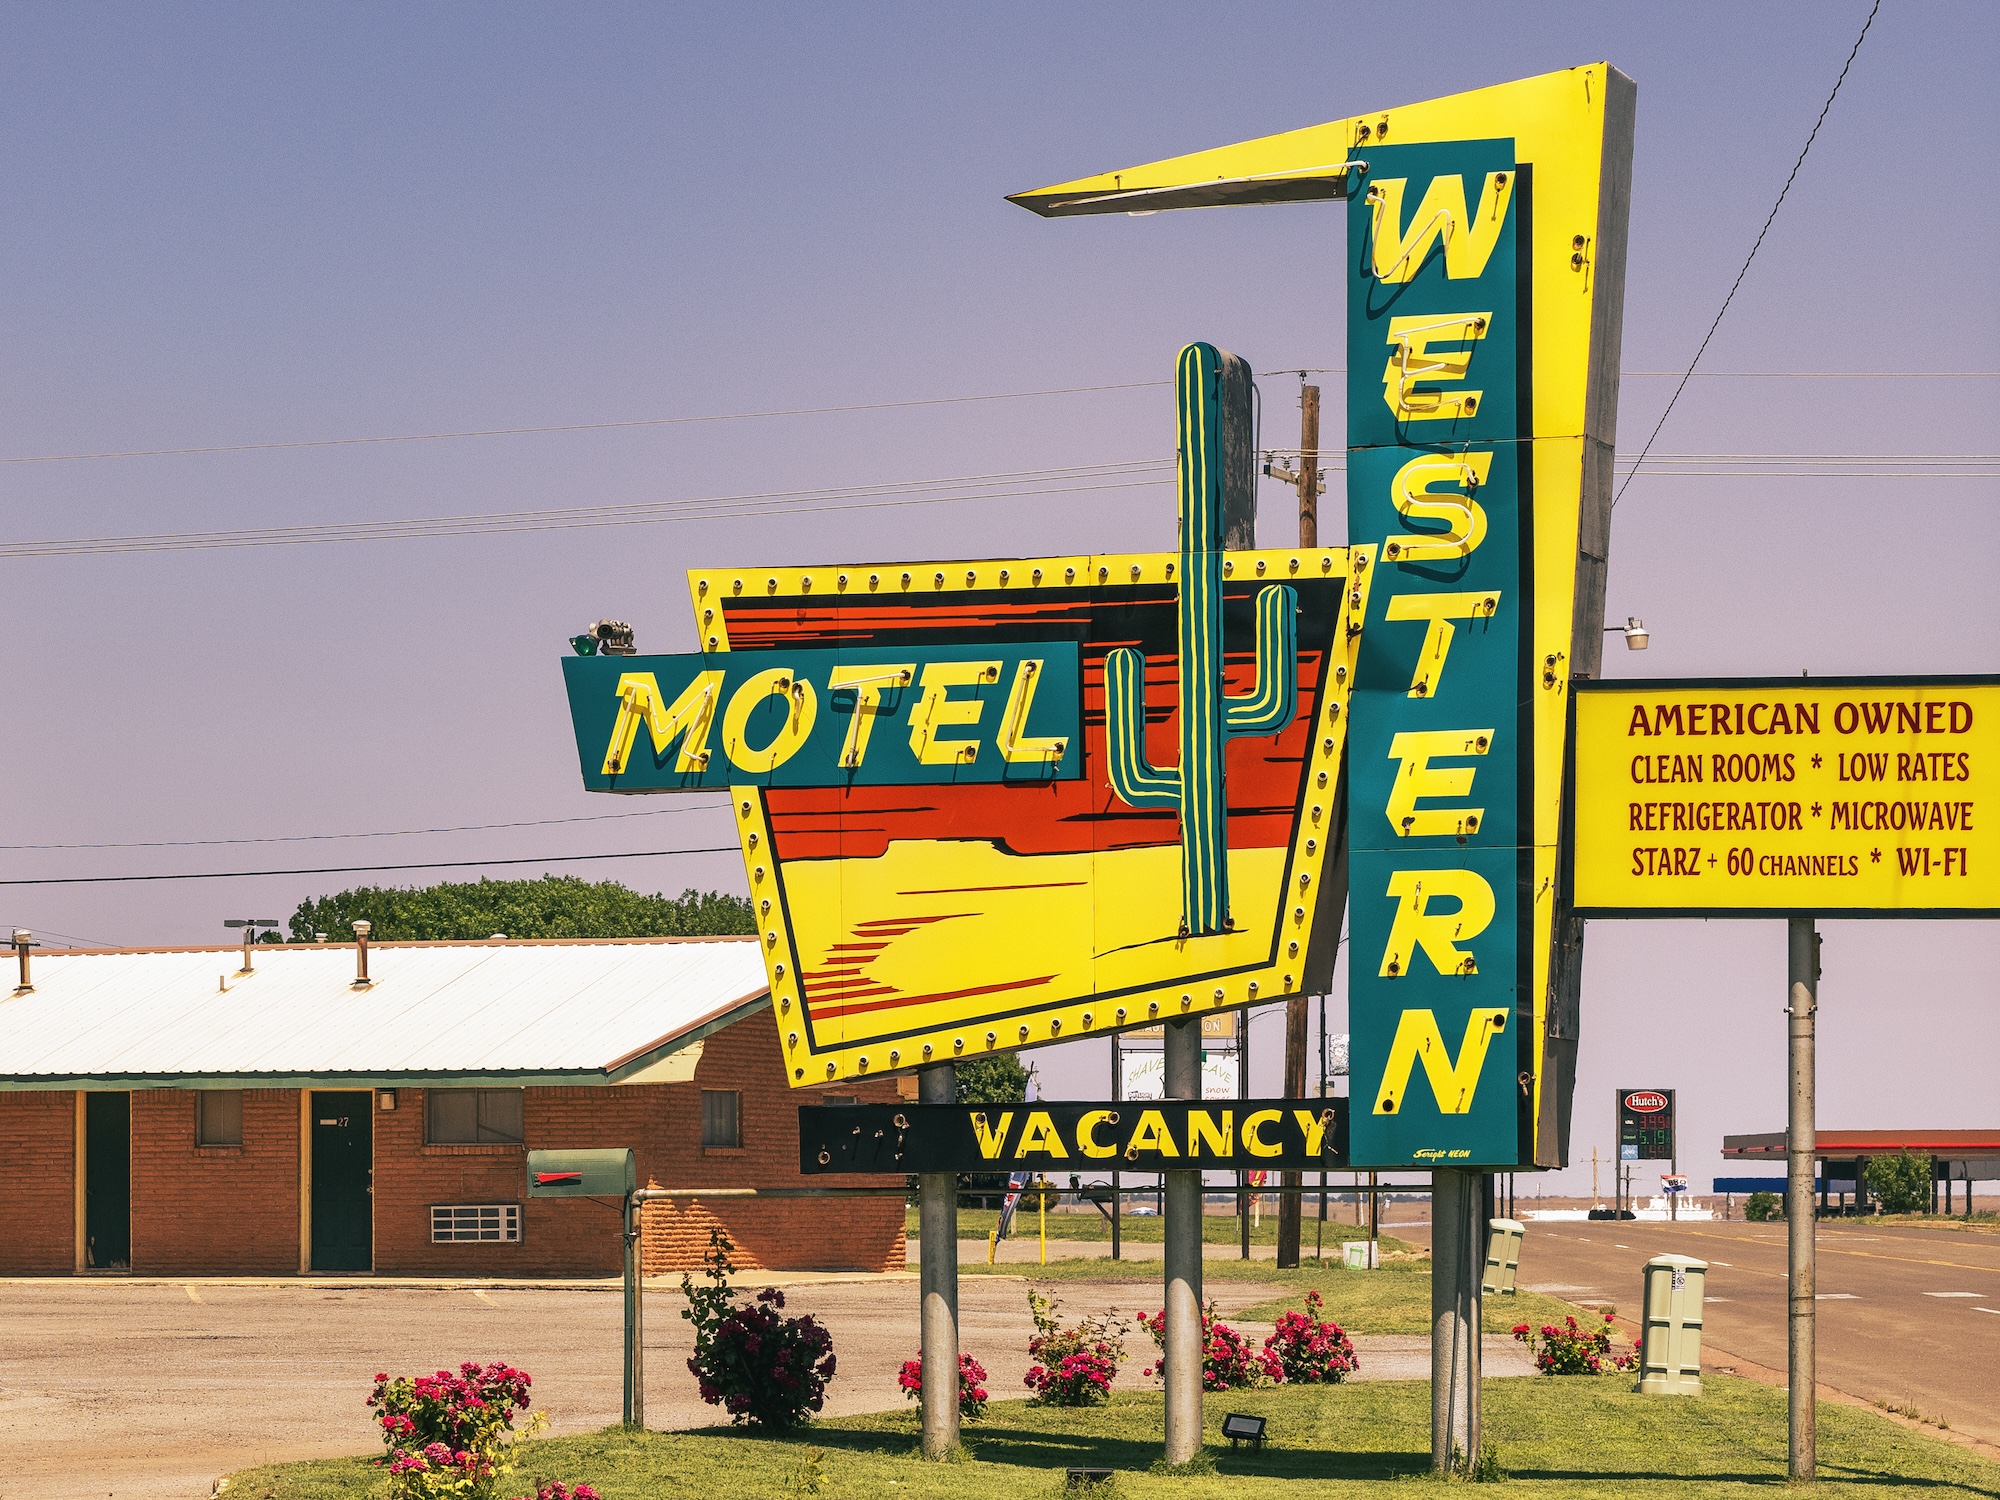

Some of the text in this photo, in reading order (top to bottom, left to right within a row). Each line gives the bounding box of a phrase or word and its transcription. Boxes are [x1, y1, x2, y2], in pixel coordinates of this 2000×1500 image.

[1364, 170, 1516, 1115] WESTERN
[601, 659, 1069, 775] MOTEL
[1627, 701, 1974, 737] AMERICAN OWNED
[1630, 752, 1970, 784] CLEAN ROOMS LOW RATES
[1628, 801, 1974, 831] REFRIGERATOR MICROWAVE
[1631, 847, 1701, 877] STARZ
[1727, 847, 1754, 876] 60
[1758, 855, 1859, 877] CHANNELS
[1895, 847, 1968, 877] WI-FI
[1631, 1095, 1664, 1106] Hutch's
[338, 1117, 349, 1127] 27
[969, 1108, 1338, 1160] VACANCY
[1447, 1149, 1471, 1158] NEON
